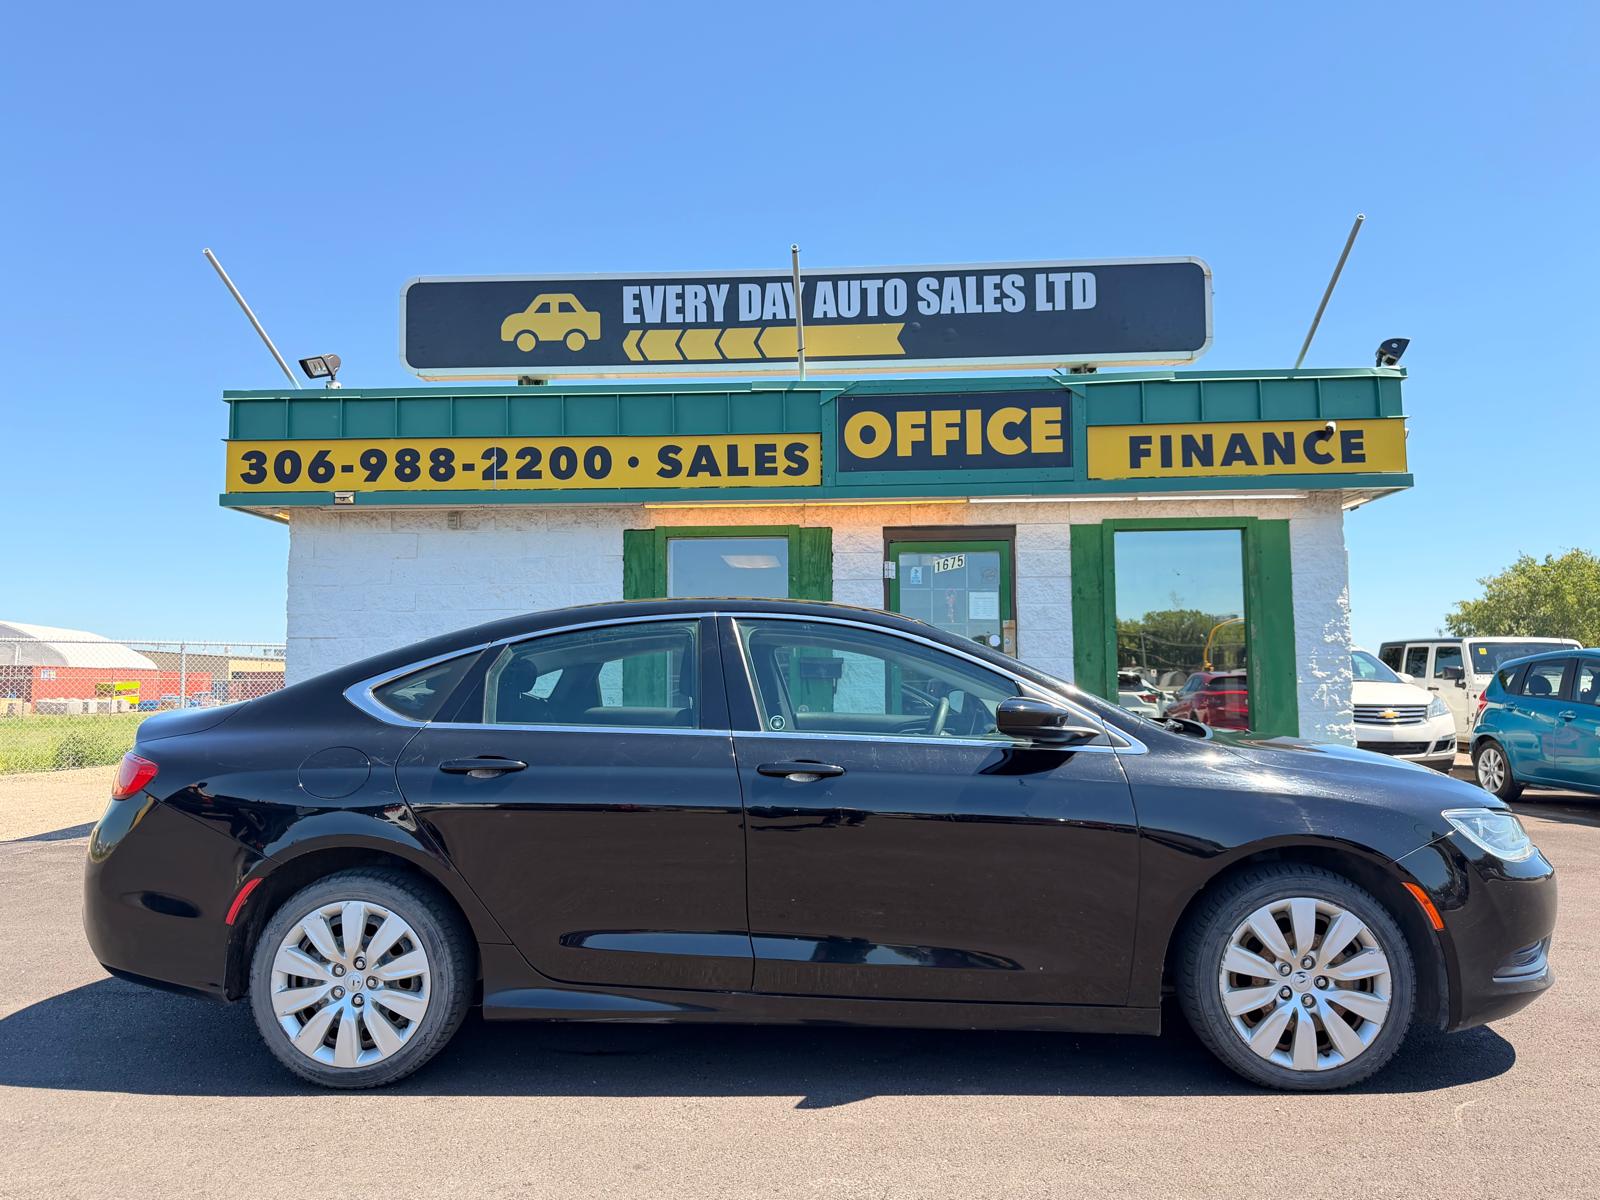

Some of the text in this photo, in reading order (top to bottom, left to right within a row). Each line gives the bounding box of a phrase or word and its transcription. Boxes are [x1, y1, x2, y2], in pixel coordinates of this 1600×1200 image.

[622, 271, 1097, 324] EVERY DAY AUTO SALES LTD
[843, 406, 1065, 460] OFFICE
[1129, 430, 1366, 469] FINANCE
[239, 442, 810, 484] 306-988-2200 SALES
[936, 555, 964, 572] 1675
